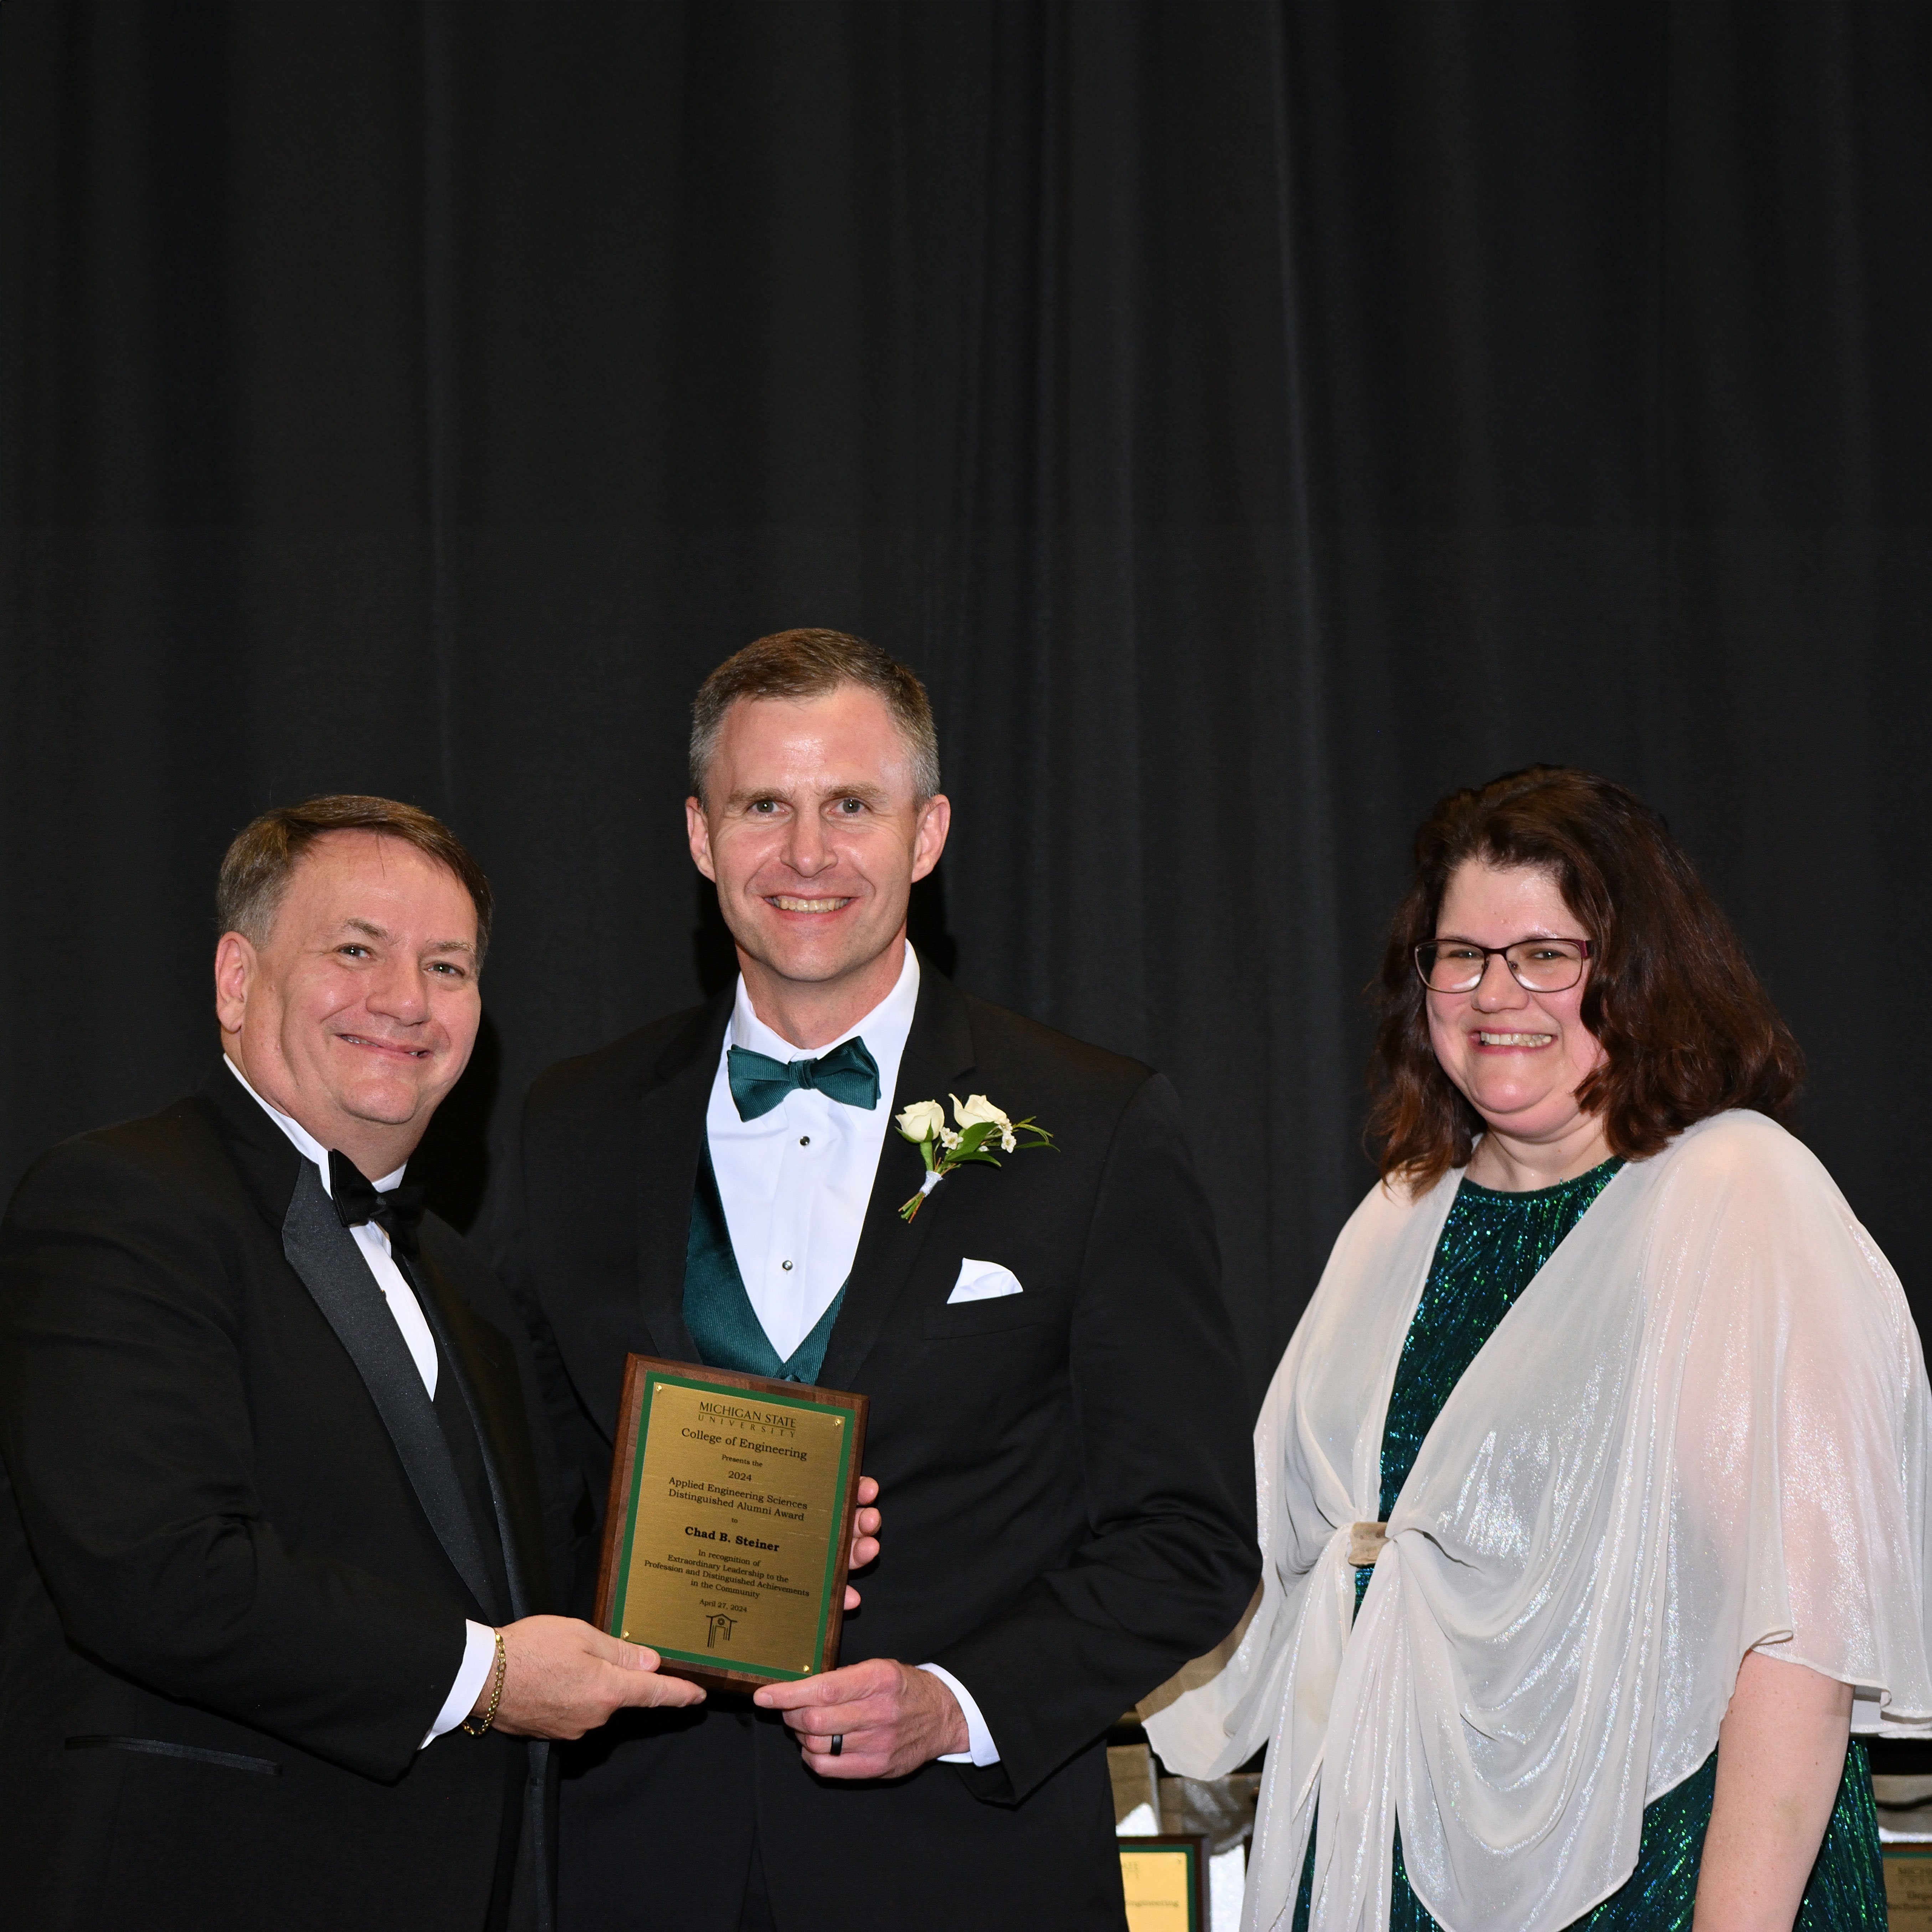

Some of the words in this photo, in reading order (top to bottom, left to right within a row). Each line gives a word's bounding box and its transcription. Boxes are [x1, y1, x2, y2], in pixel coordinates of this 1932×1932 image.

[698, 1414, 796, 1438] UNIVERSITY
[700, 1401, 761, 1421] MICHIGAN
[765, 1414, 796, 1428] STATE
[682, 1428, 721, 1444] College
[725, 1437, 737, 1446] of
[740, 1438, 807, 1461] Engineering
[722, 1454, 750, 1465] Presents
[728, 1471, 752, 1482] 2024
[669, 1477, 704, 1490] Applied
[708, 1484, 764, 1503] Engineering
[767, 1495, 807, 1509] Sciences
[669, 1489, 734, 1507] Distinguished
[737, 1502, 771, 1515] Alumni
[774, 1509, 804, 1521] Award
[685, 1526, 715, 1540] Chad
[719, 1533, 730, 1542] B.
[735, 1536, 779, 1551] Steiner
[668, 1555, 720, 1571] Extraordinary
[723, 1564, 765, 1579] Leadership
[709, 1553, 750, 1565] recognition
[644, 1560, 683, 1573] Profession
[703, 1571, 755, 1586] Distinguished
[757, 1582, 809, 1596] Achievements
[700, 1599, 715, 1607] April
[715, 1584, 760, 1598] Community
